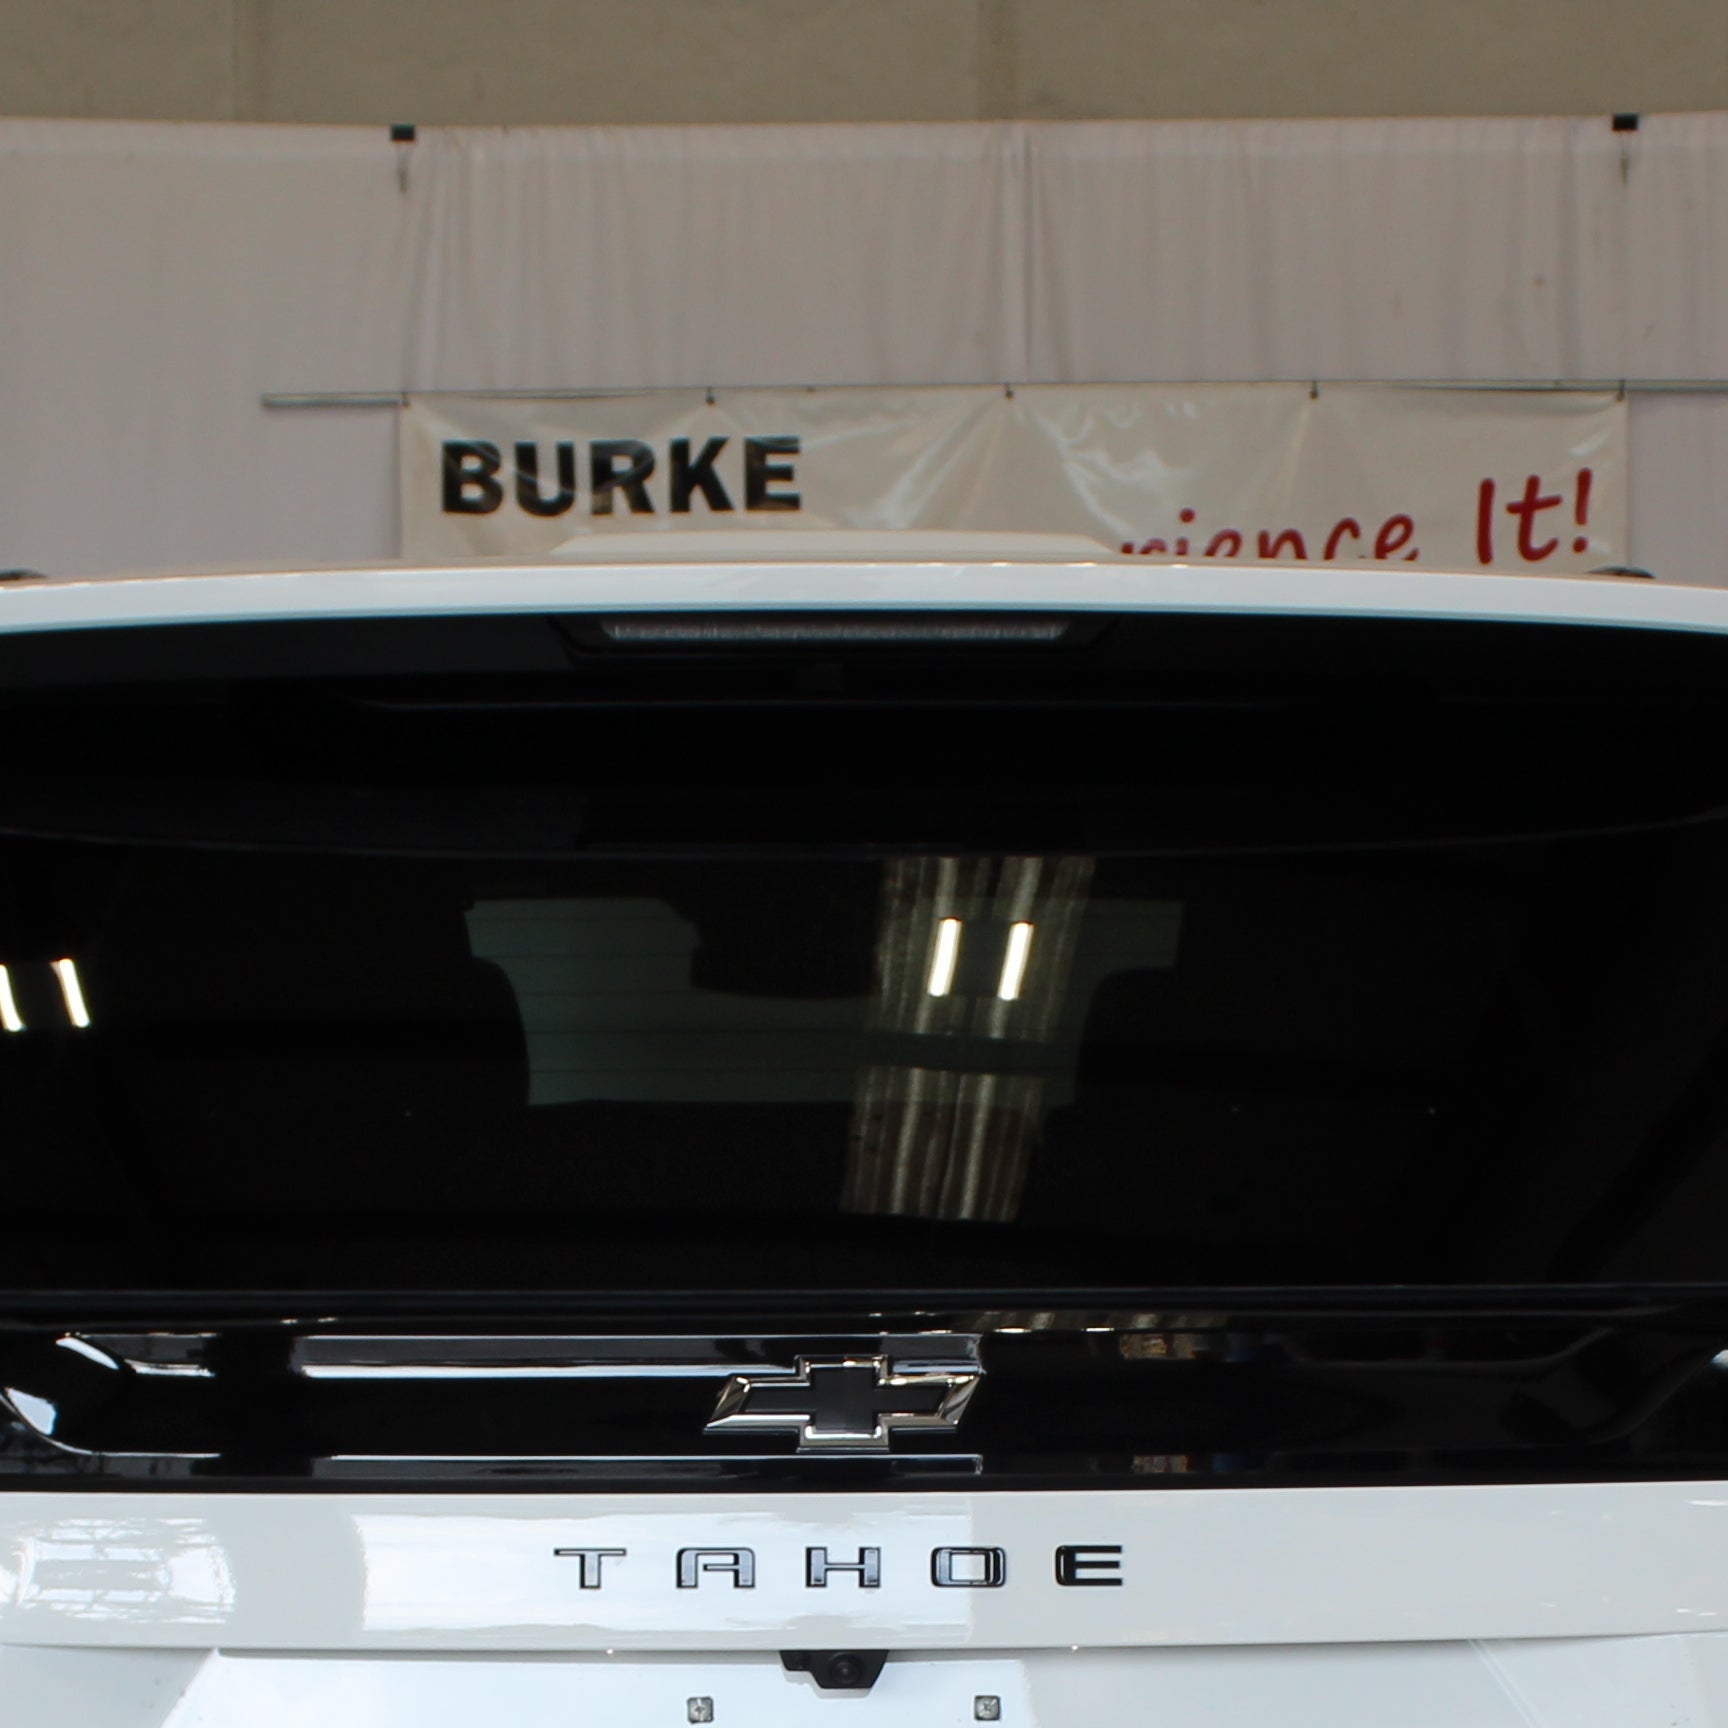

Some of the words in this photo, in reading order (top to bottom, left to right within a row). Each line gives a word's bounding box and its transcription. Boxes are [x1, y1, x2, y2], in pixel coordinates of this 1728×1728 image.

[440, 435, 802, 518] BURKE
[1475, 468, 1593, 567] It!
[553, 1544, 1124, 1590] TAHOE
